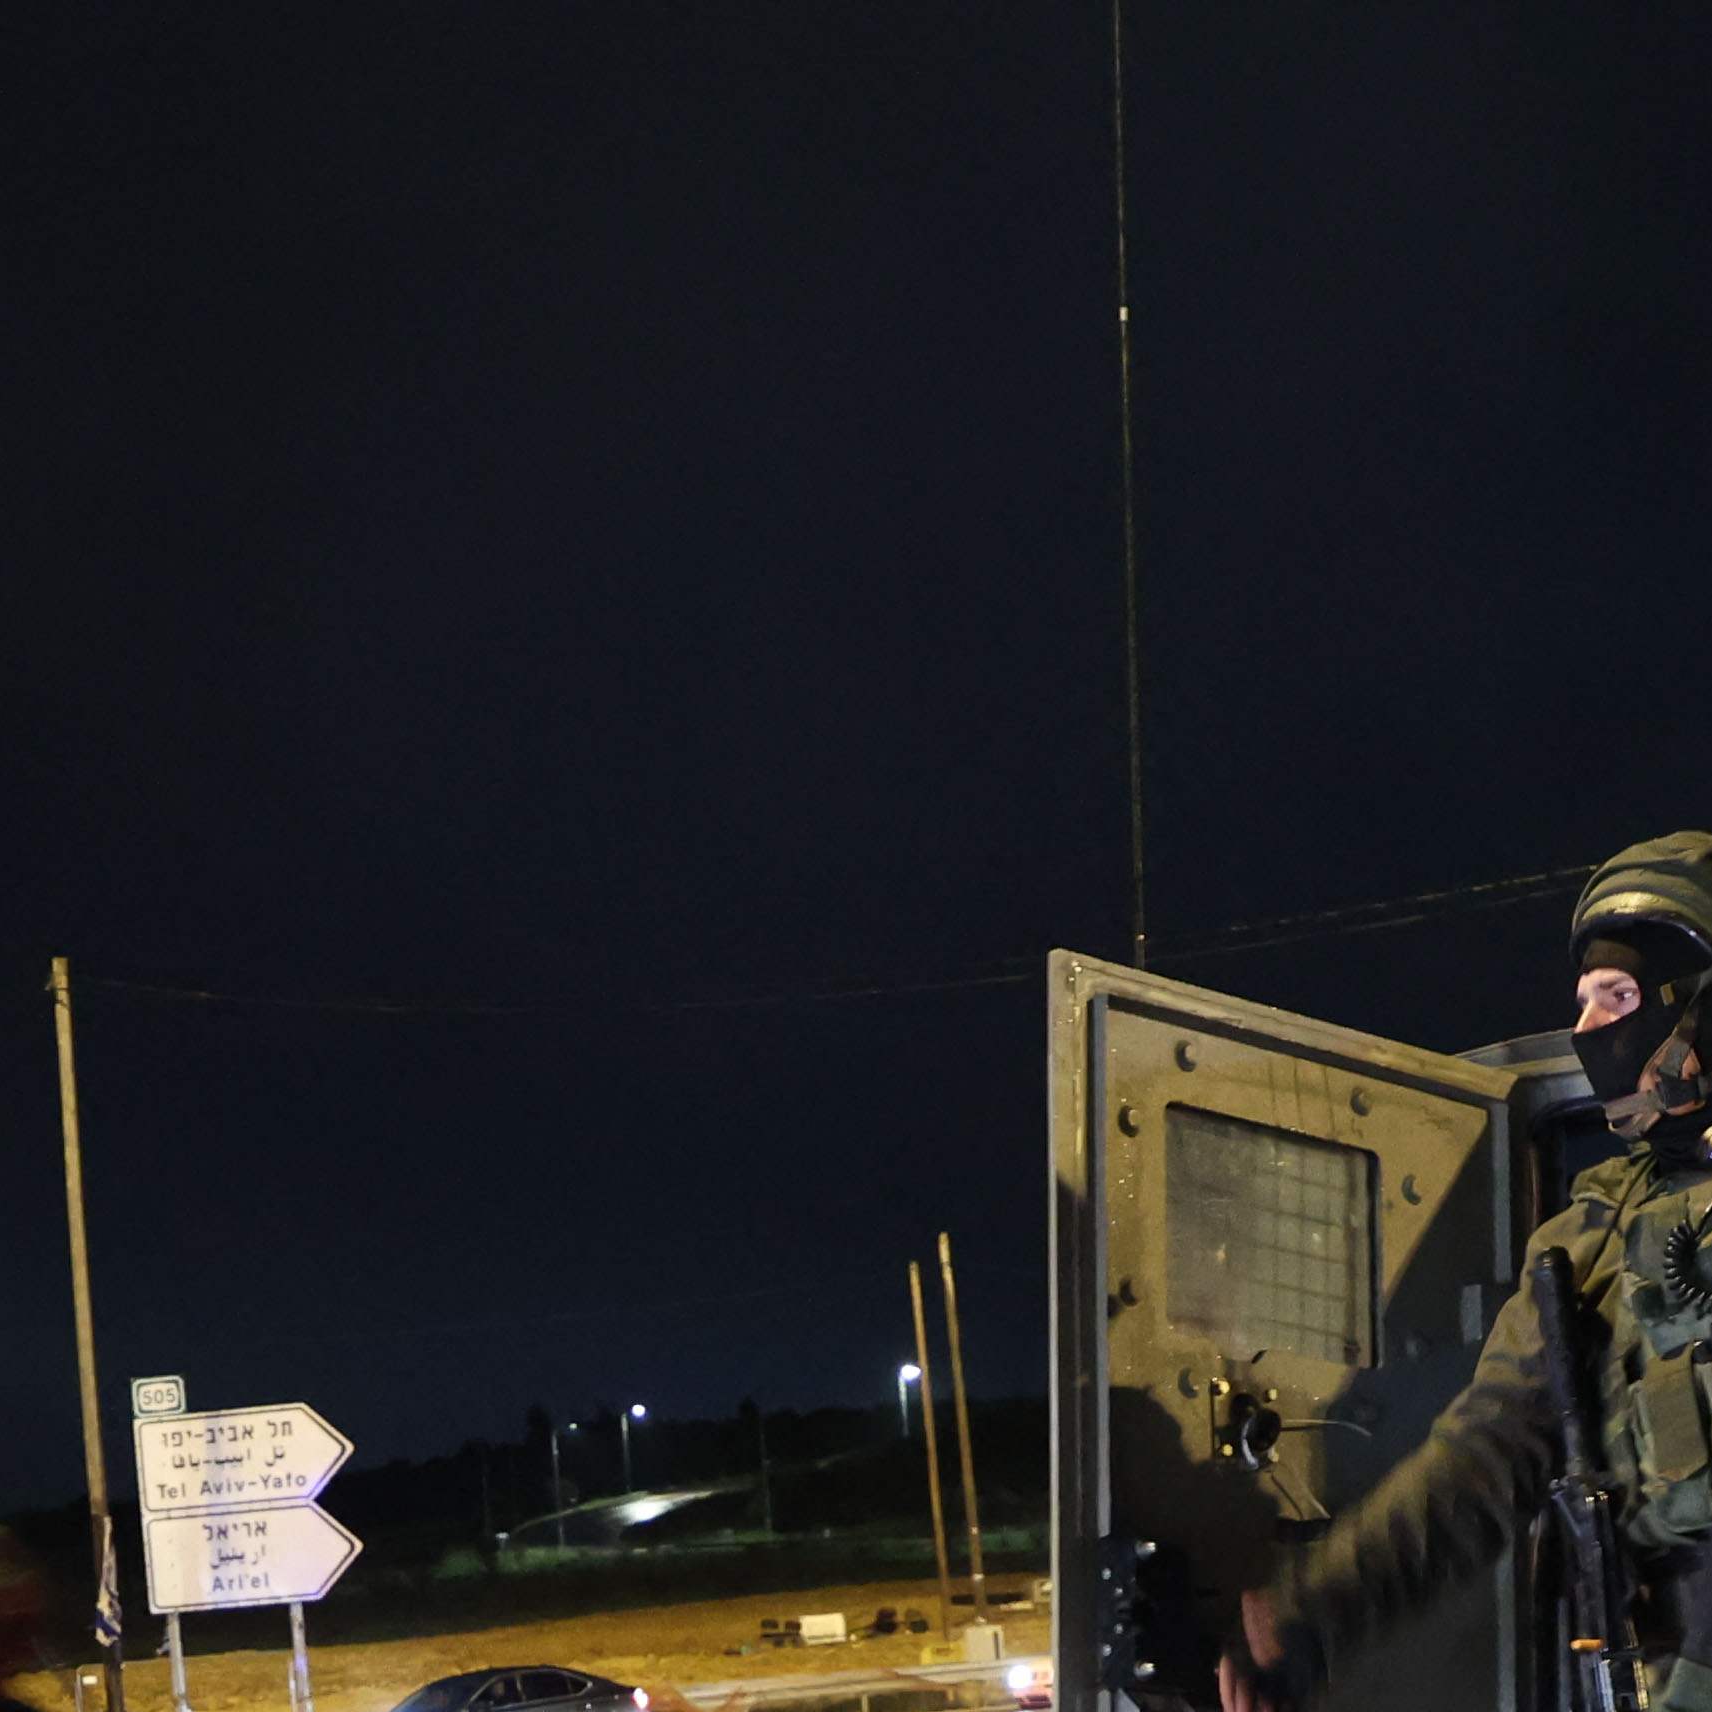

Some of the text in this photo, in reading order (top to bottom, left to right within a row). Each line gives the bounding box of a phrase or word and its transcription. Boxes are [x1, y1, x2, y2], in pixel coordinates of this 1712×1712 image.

[142, 1387, 177, 1406] 505
[162, 1420, 293, 1447] תל אביב-יפו
[264, 1445, 285, 1466] تل
[157, 1472, 307, 1499] Tel Aviv-Yafo
[202, 1521, 267, 1541] אריאל
